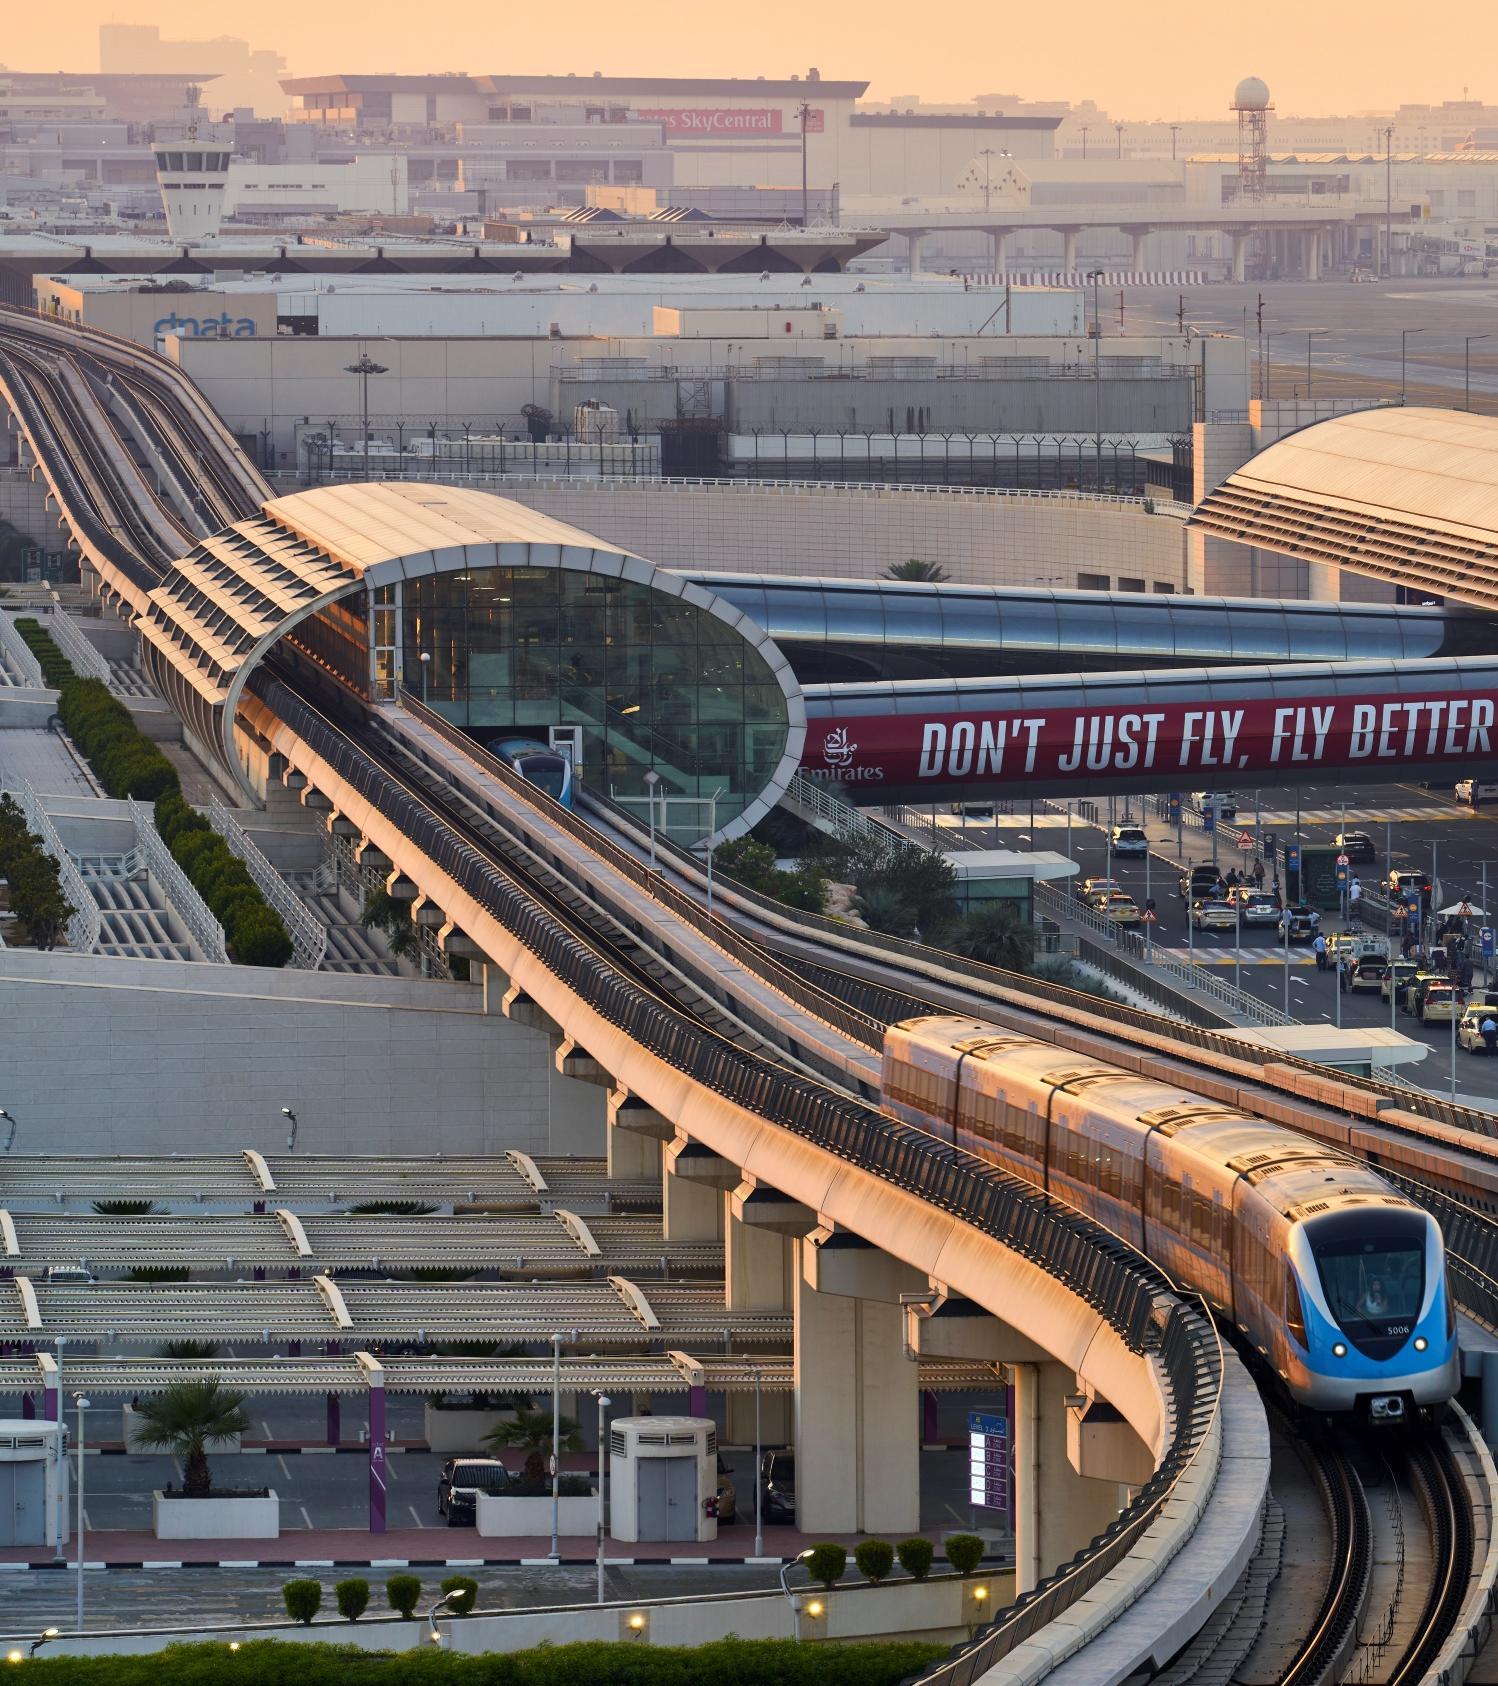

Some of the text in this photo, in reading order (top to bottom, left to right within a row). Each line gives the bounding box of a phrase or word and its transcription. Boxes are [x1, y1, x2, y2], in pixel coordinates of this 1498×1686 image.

[682, 112, 771, 131] SkyCentral
[918, 699, 1495, 777] DON'T JUST FLY, FLY BETTER
[986, 1438, 991, 1447] A
[374, 1447, 383, 1458] A
[986, 1452, 991, 1461] B
[986, 1466, 991, 1475] C
